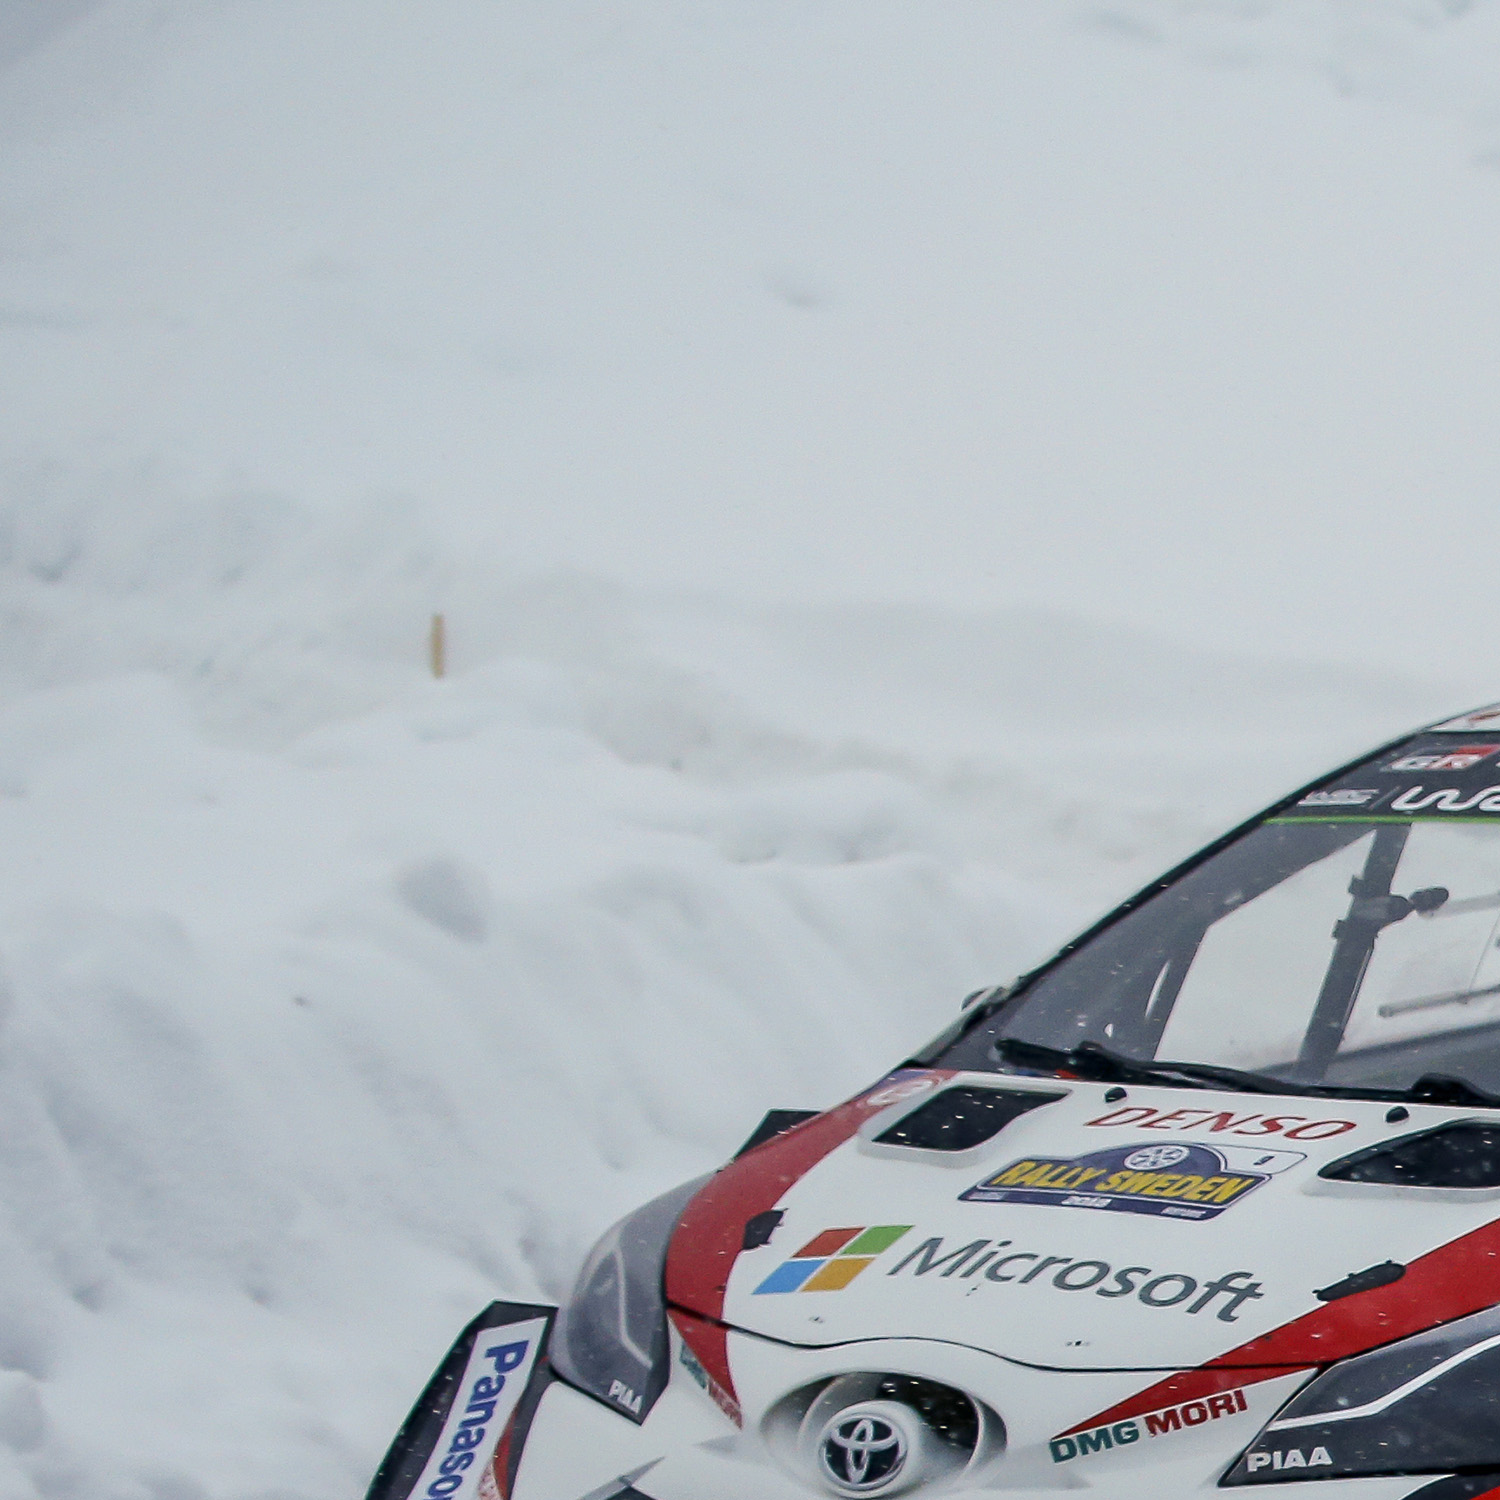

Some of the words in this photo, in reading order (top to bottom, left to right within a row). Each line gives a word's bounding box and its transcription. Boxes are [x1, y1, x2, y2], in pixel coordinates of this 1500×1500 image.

[1084, 1106, 1357, 1140] DENSO
[990, 1161, 1105, 1189] RALLY
[1096, 1169, 1255, 1205] SWEDEN
[888, 1236, 1265, 1323] Microsoft
[1049, 1421, 1141, 1465] DMG
[1144, 1387, 1247, 1438] MORI
[1247, 1446, 1333, 1472] PIAA
